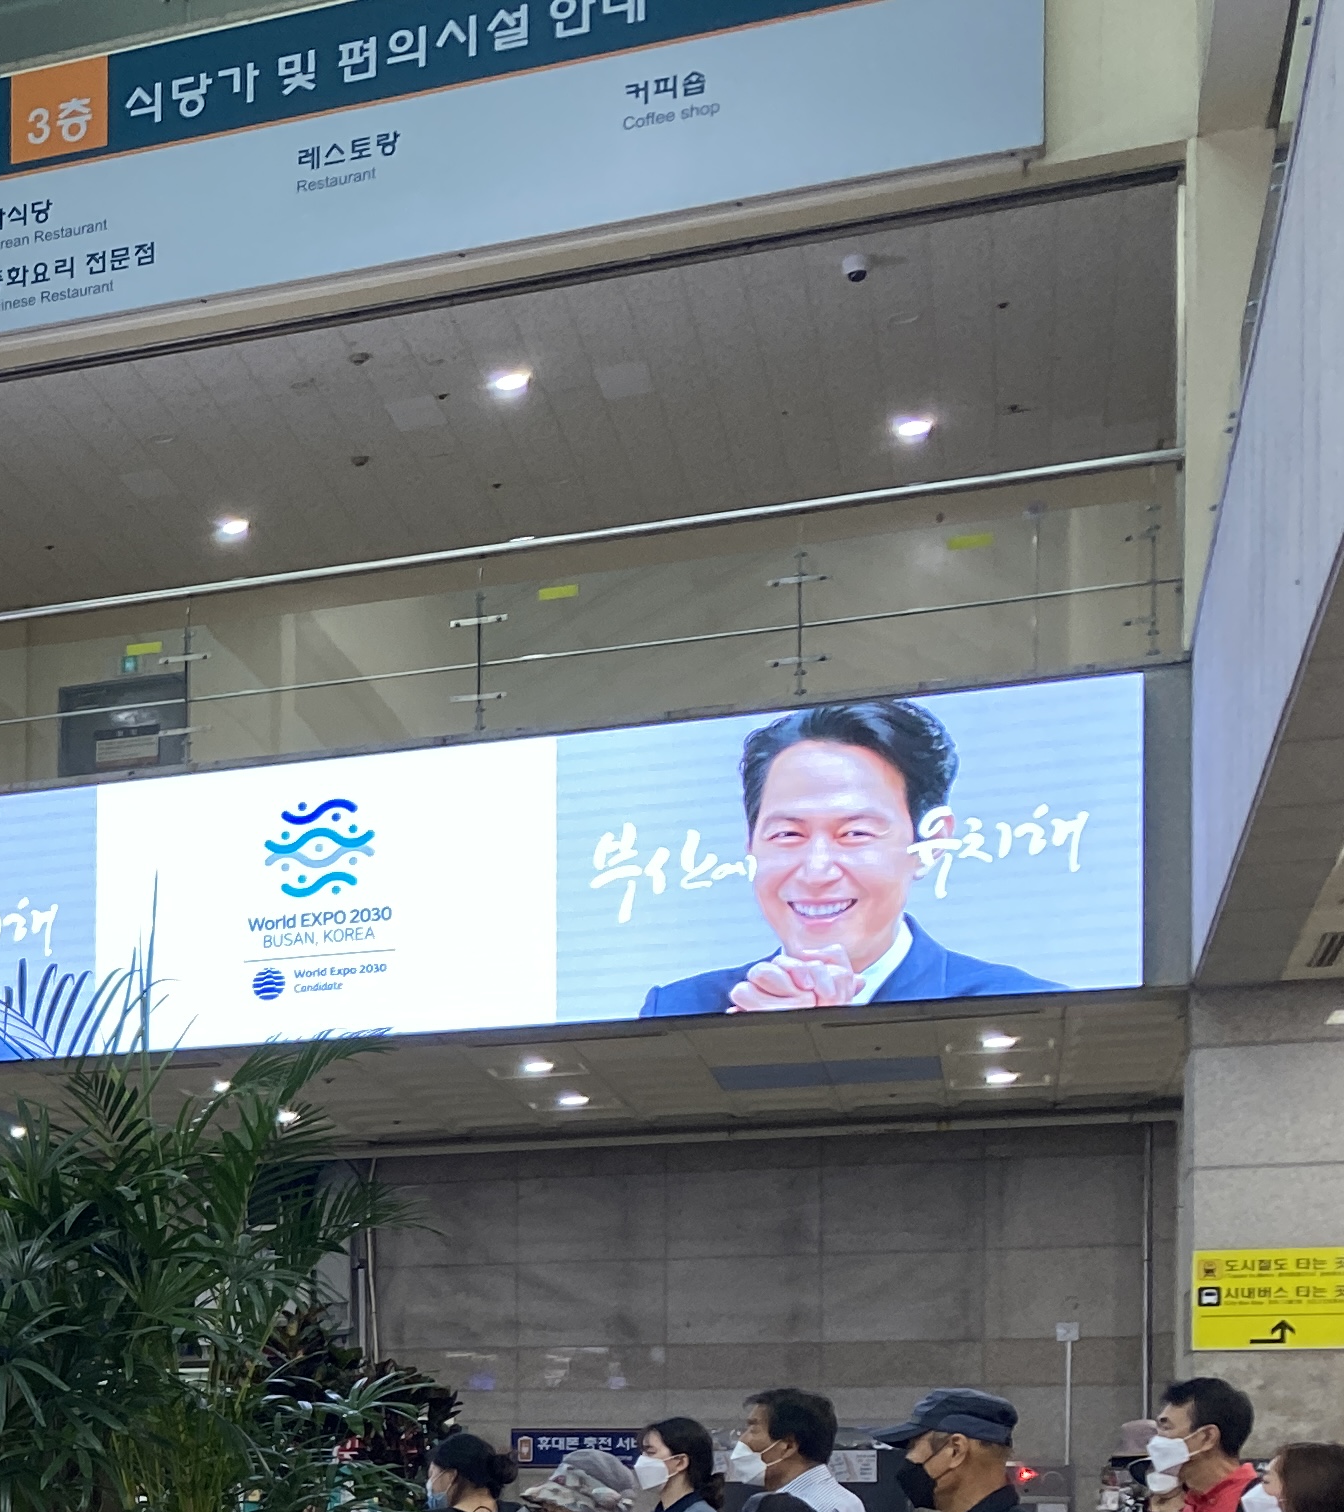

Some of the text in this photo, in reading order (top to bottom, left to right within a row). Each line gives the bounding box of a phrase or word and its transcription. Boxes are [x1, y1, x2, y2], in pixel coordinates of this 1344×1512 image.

[27, 97, 93, 147] 3층
[124, 61, 260, 122] 식당가
[276, 49, 317, 97] 및
[336, 10, 531, 84] 편의시설
[625, 70, 707, 105] 커피숍
[622, 101, 721, 131] Coffee shop
[296, 130, 401, 171] 레스토랑
[296, 167, 377, 193] Restaurant
[33, 218, 108, 244] Restaurant
[86, 240, 156, 278] 전문점
[39, 279, 115, 304] Restaurant
[588, 822, 758, 924] 부산에
[247, 906, 392, 932] World EXPO 2030
[263, 926, 375, 948] BUSAN, KOREA
[293, 963, 388, 979] World Expo 2030
[293, 982, 343, 994] Candidate
[1295, 1257, 1328, 1270] 타는
[1224, 1285, 1328, 1299] 시내버스 타는
[537, 1436, 580, 1451] 휴대폰
